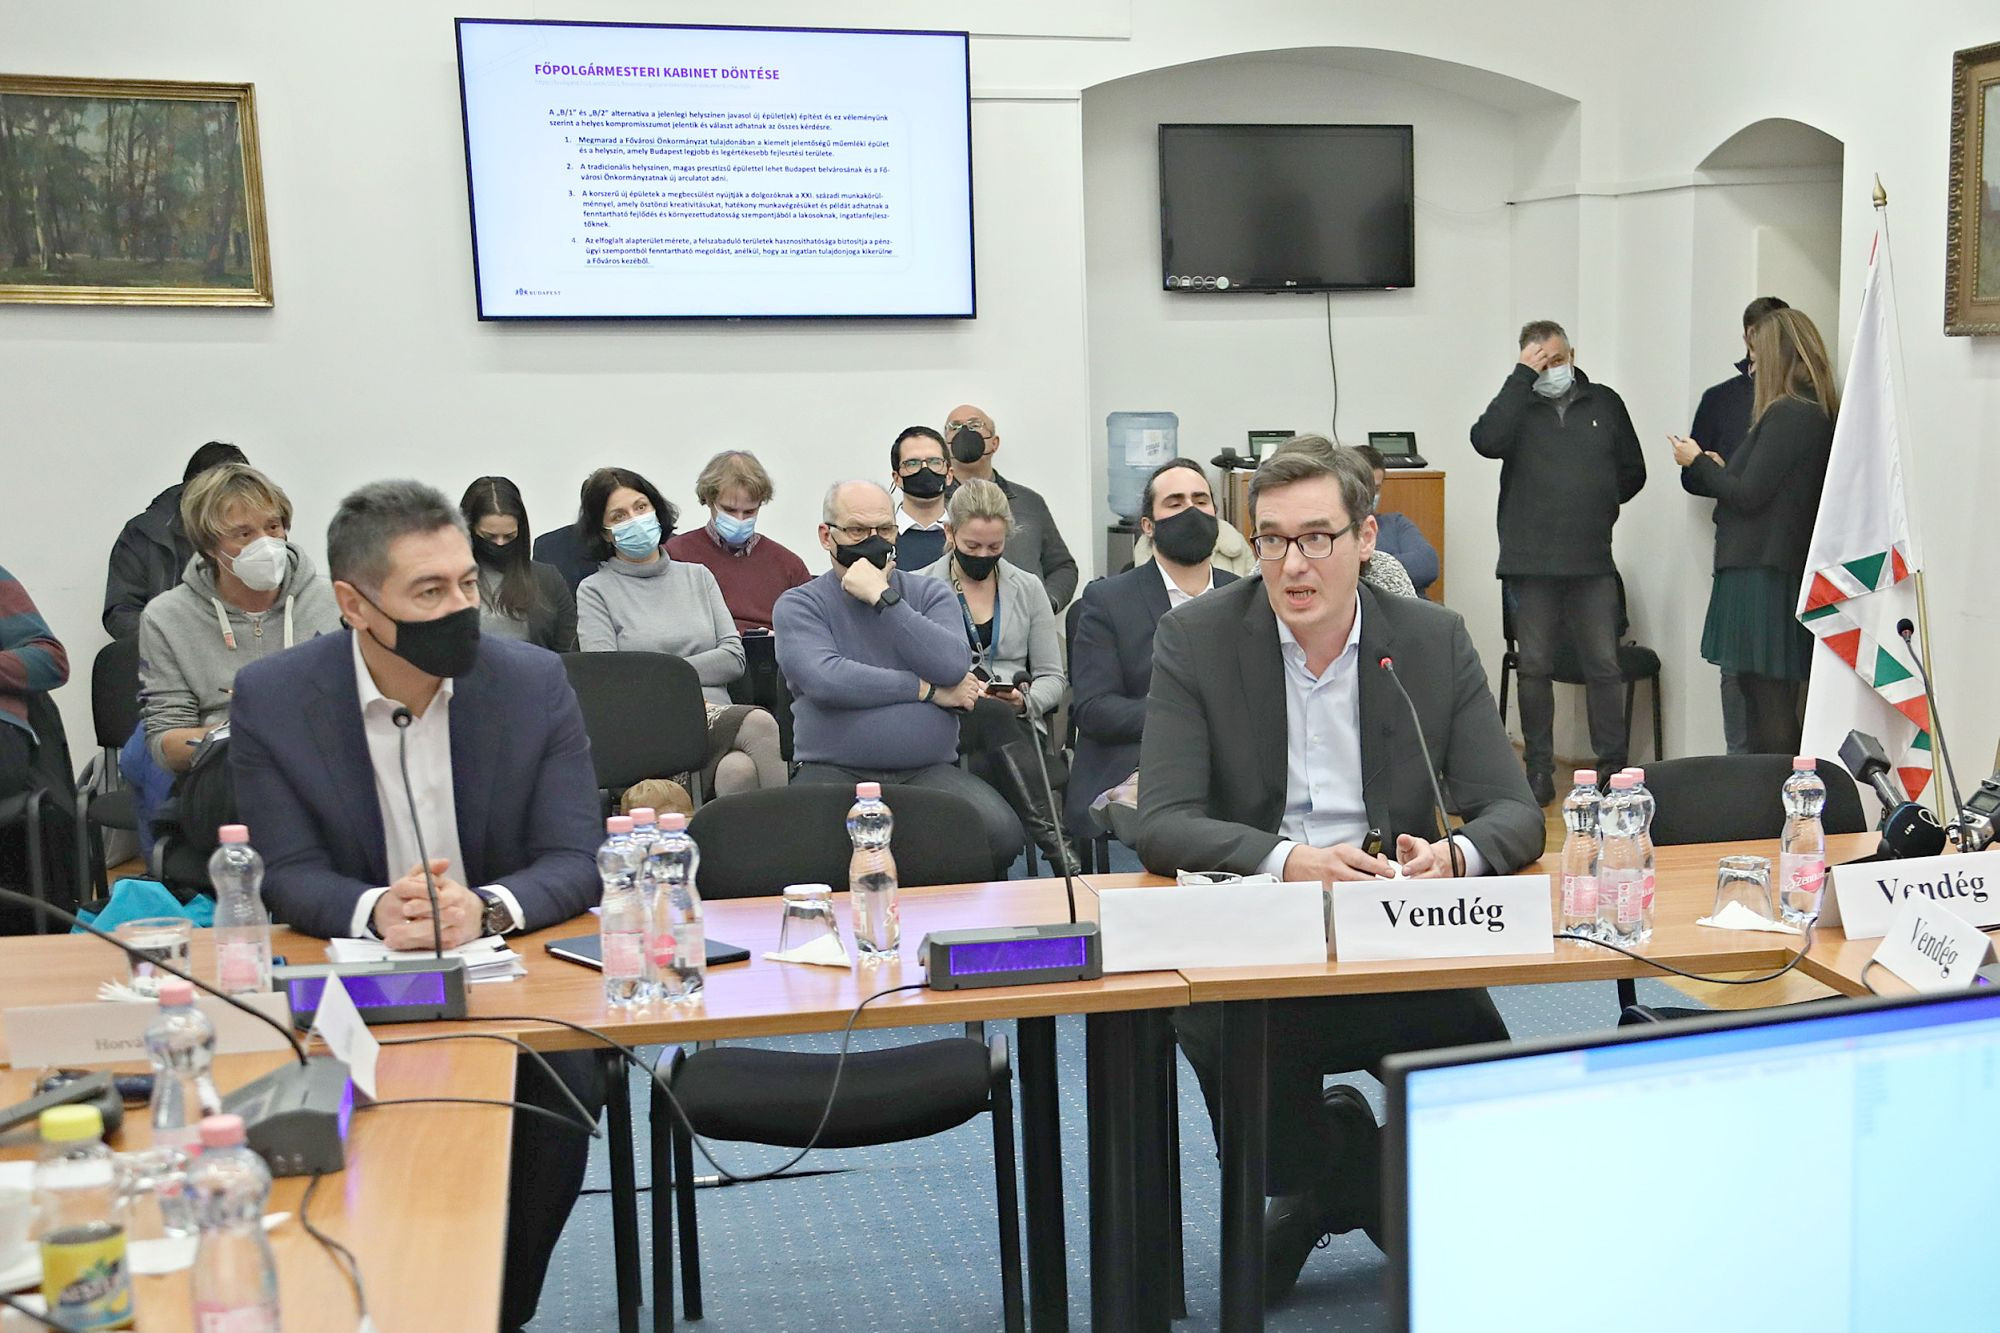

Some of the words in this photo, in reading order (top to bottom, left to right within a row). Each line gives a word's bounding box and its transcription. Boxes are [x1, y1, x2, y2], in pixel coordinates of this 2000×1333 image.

[534, 61, 660, 78] FŐPOLGÁRMESTERI
[663, 67, 717, 79] KABINET
[721, 66, 779, 79] DÖNTÉSE
[657, 110, 687, 119] jelenlegi
[727, 111, 751, 120] javasol
[762, 111, 797, 121] épület(ek)
[824, 112, 832, 120] és
[842, 112, 888, 122] véleményünk
[549, 119, 574, 127] szerint
[581, 120, 604, 129] helyes
[605, 120, 671, 130] kompromisszumot
[672, 121, 698, 130] jelentik
[700, 121, 708, 129] és
[709, 121, 733, 129] választ
[777, 122, 799, 130] összes
[578, 136, 617, 146] Megmarad
[656, 136, 708, 146] Önkormányzat
[709, 137, 755, 147] tulajdonában
[763, 138, 789, 146] kiemelt
[867, 139, 889, 149] épület
[627, 147, 648, 157] amely
[649, 147, 683, 157] Budapest
[683, 148, 710, 157] legjobb
[720, 148, 768, 158] legértékesebb
[770, 148, 803, 158] fejlesztési
[587, 163, 630, 171] tradicionális
[672, 165, 695, 173] magas
[732, 164, 763, 173] épülettel
[765, 164, 783, 172] lehet
[784, 164, 816, 174] Budapest
[818, 165, 862, 173] belvárosának
[864, 165, 872, 173] és
[580, 173, 602, 181] városi
[603, 172, 667, 183] Önkormányzatnak
[629, 190, 660, 199] épületek
[667, 190, 714, 199] megbecsülést
[750, 190, 793, 200] dolgozóknak
[617, 200, 638, 210] amely
[639, 200, 668, 208] ösztönzi
[724, 201, 756, 210] hatékony
[758, 201, 818, 210] munkavégzésüket
[820, 201, 827, 209] és
[829, 201, 850, 210] példát
[852, 201, 883, 209] adhatnak
[668, 210, 740, 220] környezettudatosság
[741, 210, 791, 220] szempontjából
[594, 236, 623, 245] elfoglalt
[625, 236, 663, 245] alapterület
[698, 236, 741, 244] felszabaduló
[742, 236, 773, 244] területek
[585, 247, 601, 256] ügyi
[602, 247, 647, 256] szempontból
[762, 247, 779, 256] hogy
[789, 247, 817, 256] ingatlan
[818, 247, 860, 256] tulajdonjoga
[862, 247, 892, 255] kikerülne
[1875, 871, 1989, 904] Vendég
[1380, 897, 1505, 932] Vendég
[1911, 917, 1958, 979] Vendég
